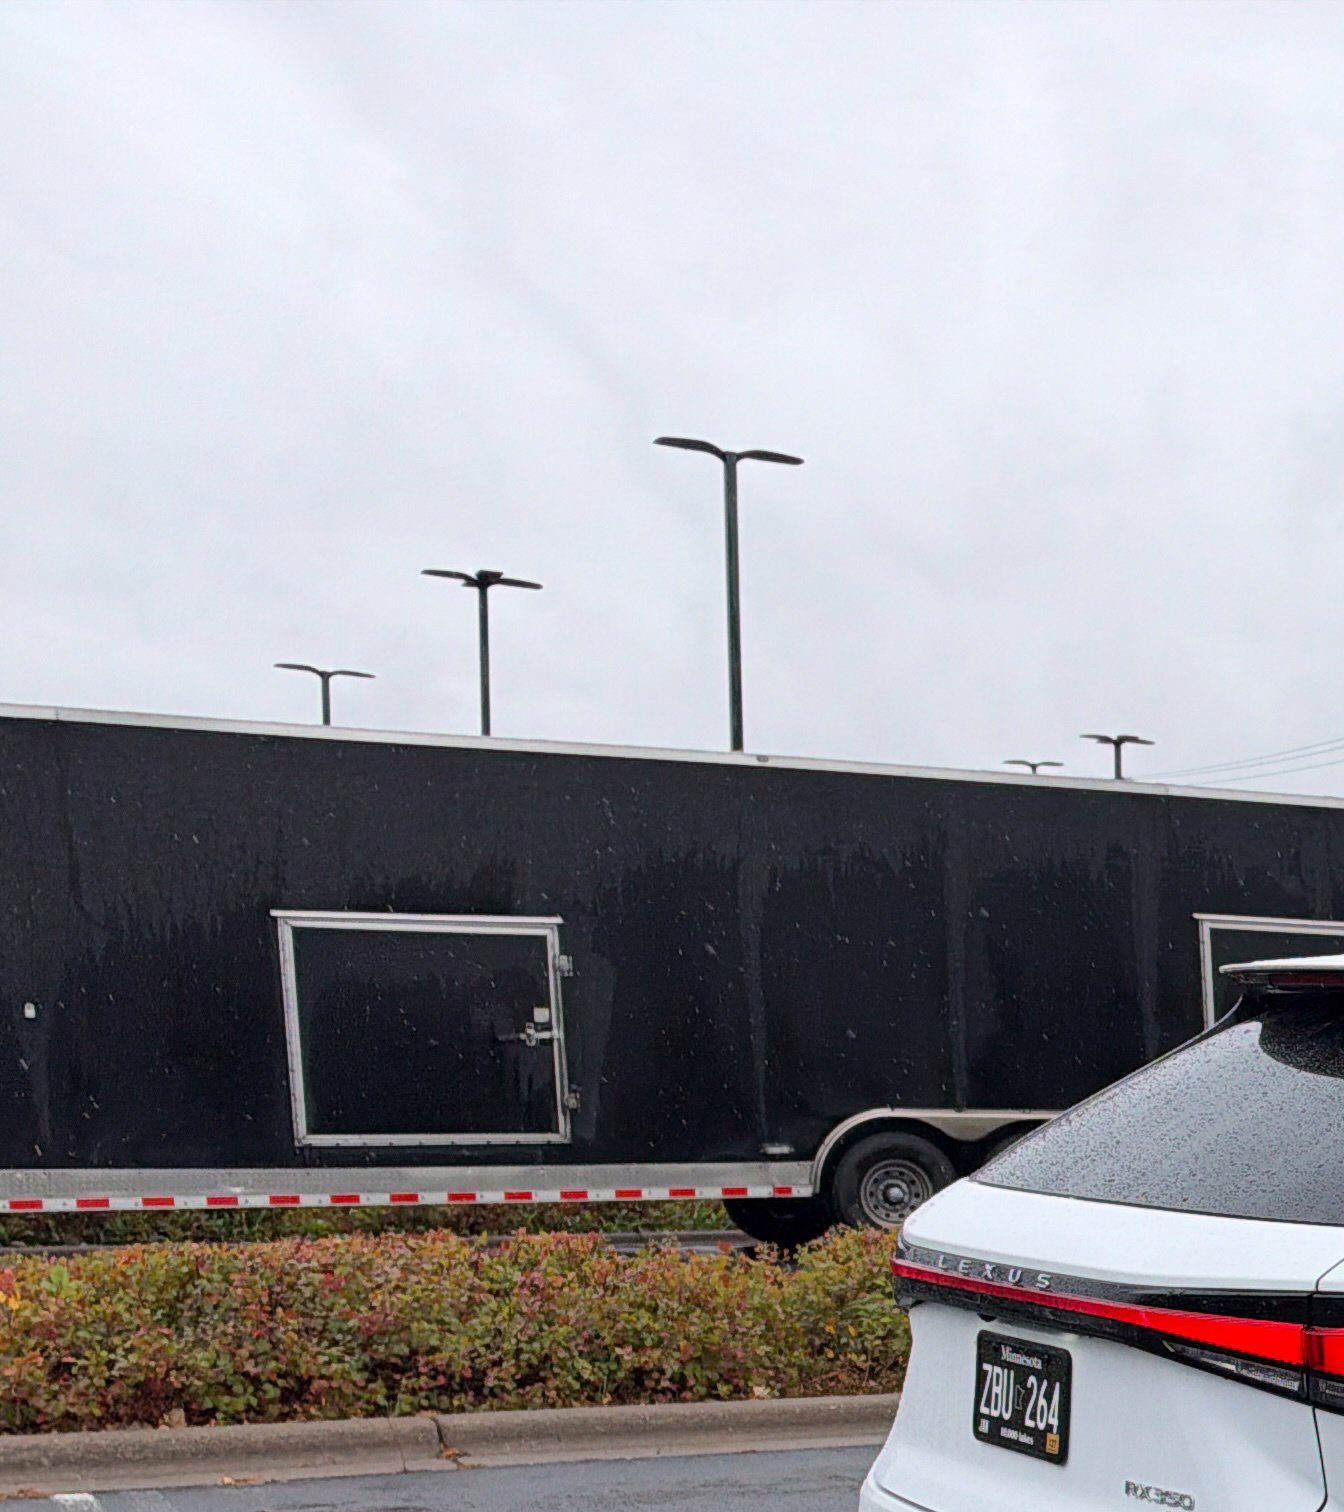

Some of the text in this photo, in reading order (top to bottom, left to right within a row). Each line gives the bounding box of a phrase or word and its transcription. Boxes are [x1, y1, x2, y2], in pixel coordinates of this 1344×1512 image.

[938, 1254, 1053, 1289] LEXUS
[1000, 1343, 1042, 1370] Minnesota
[979, 1362, 1060, 1434] ZBU 264
